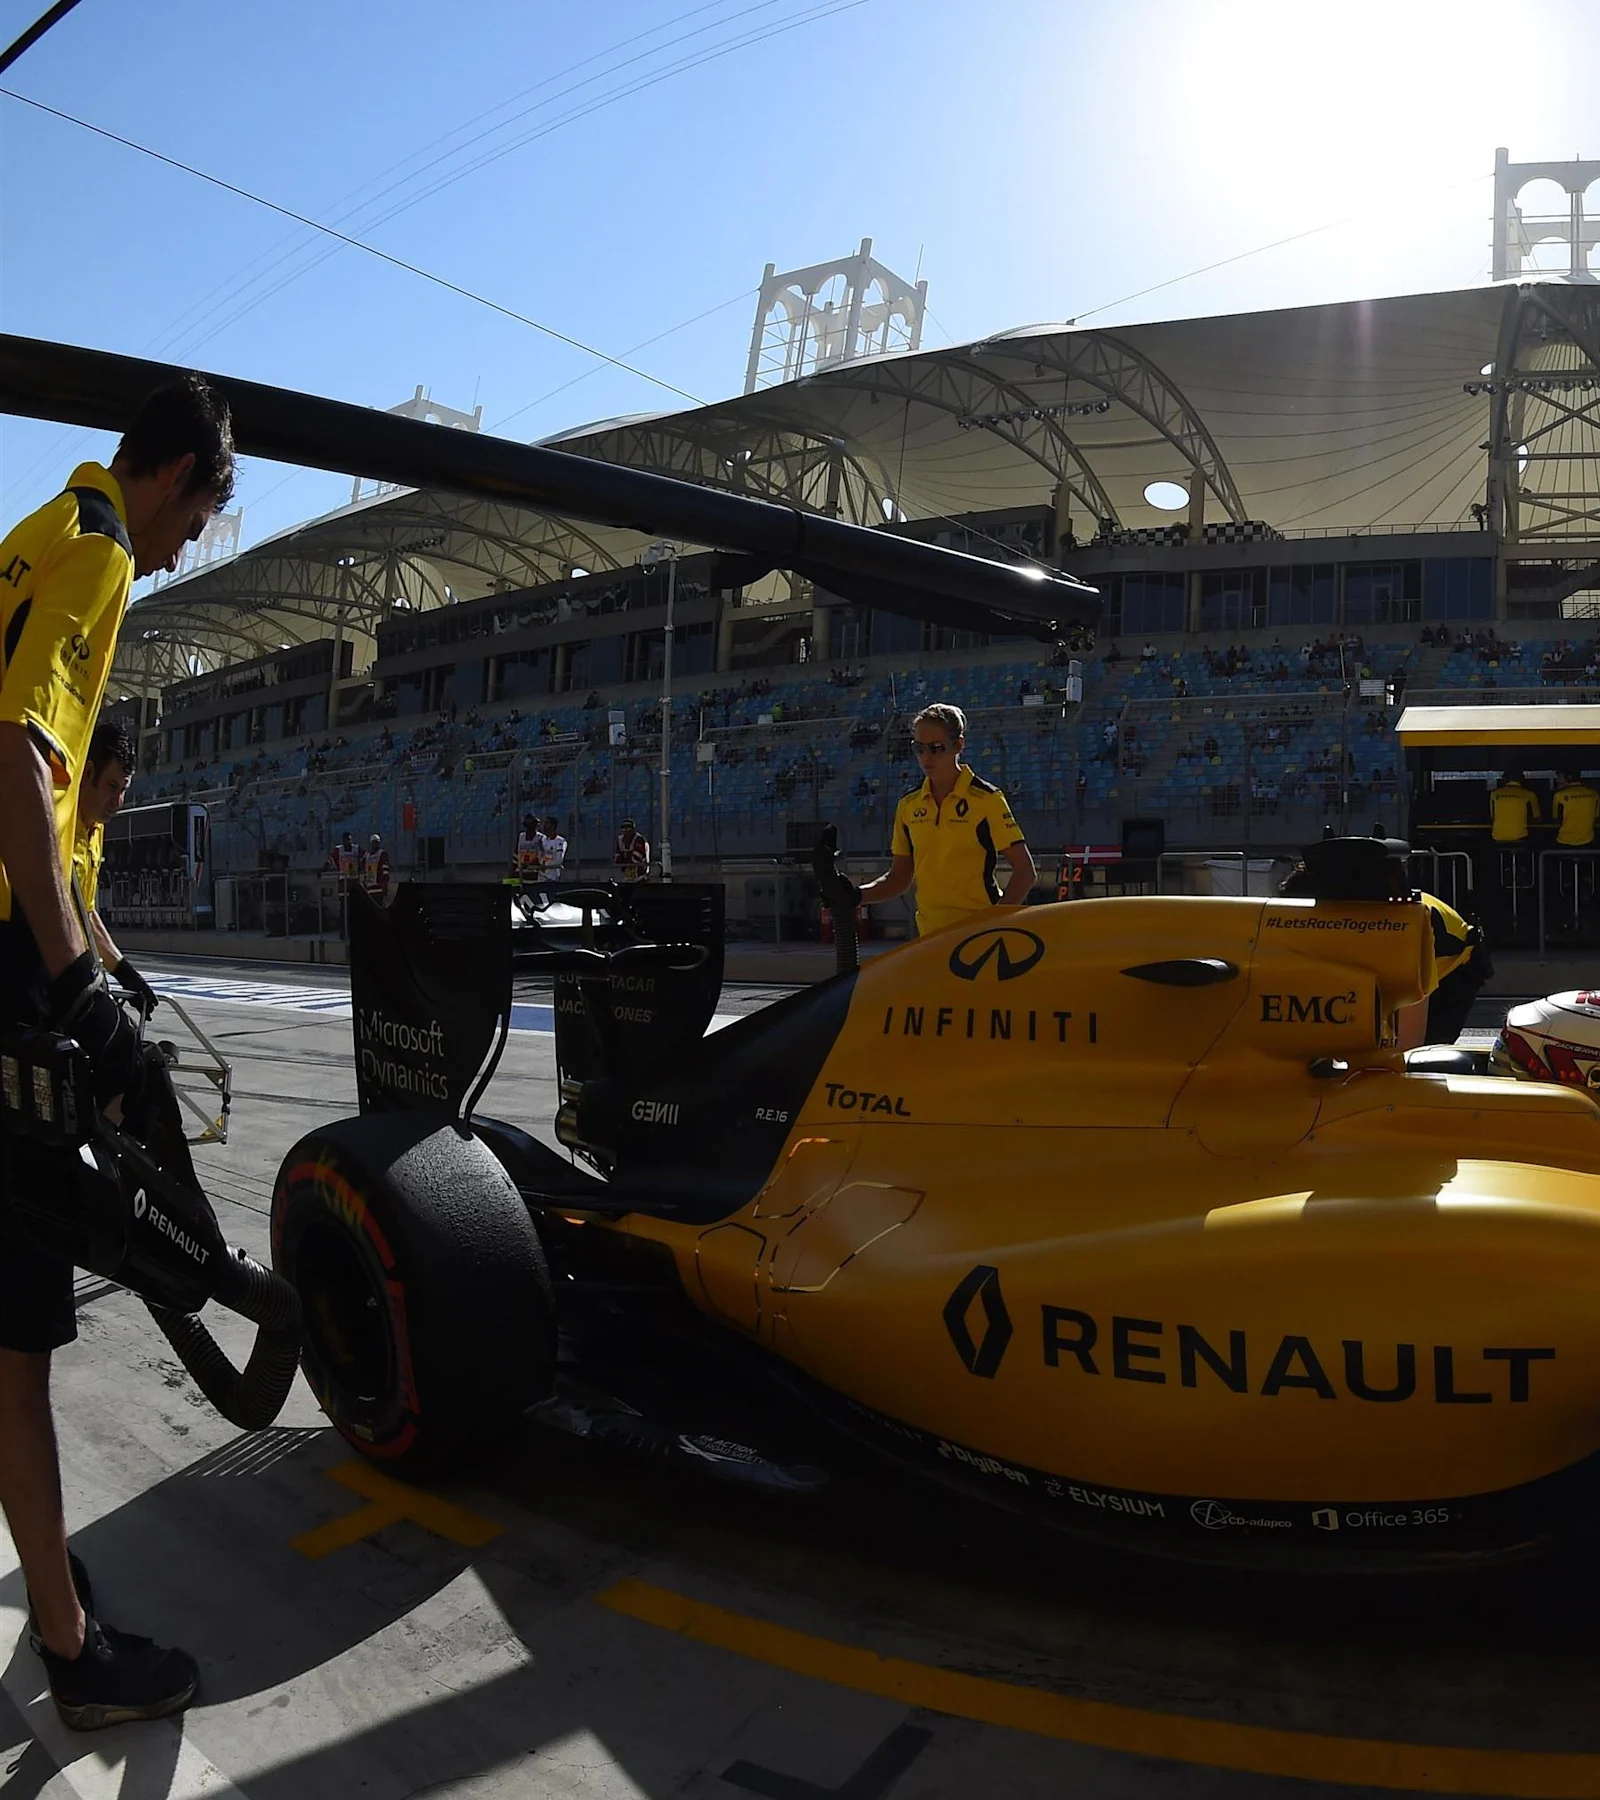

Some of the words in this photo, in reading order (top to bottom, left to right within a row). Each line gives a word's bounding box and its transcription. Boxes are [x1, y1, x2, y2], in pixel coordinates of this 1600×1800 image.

[1266, 917, 1408, 933] #LetsRaceTogether
[359, 1008, 445, 1057] Microsoft
[884, 1007, 1098, 1043] INFINITI
[362, 1048, 449, 1101] Dynamics
[825, 1083, 911, 1117] TOTAL
[148, 1205, 211, 1265] RENAULT
[1041, 1304, 1556, 1404] RENAULT
[1068, 1486, 1165, 1519] ELYSIUM
[1345, 1510, 1407, 1528] Office
[1411, 1508, 1449, 1526] 365
[1228, 1516, 1292, 1529] CD-adapco
